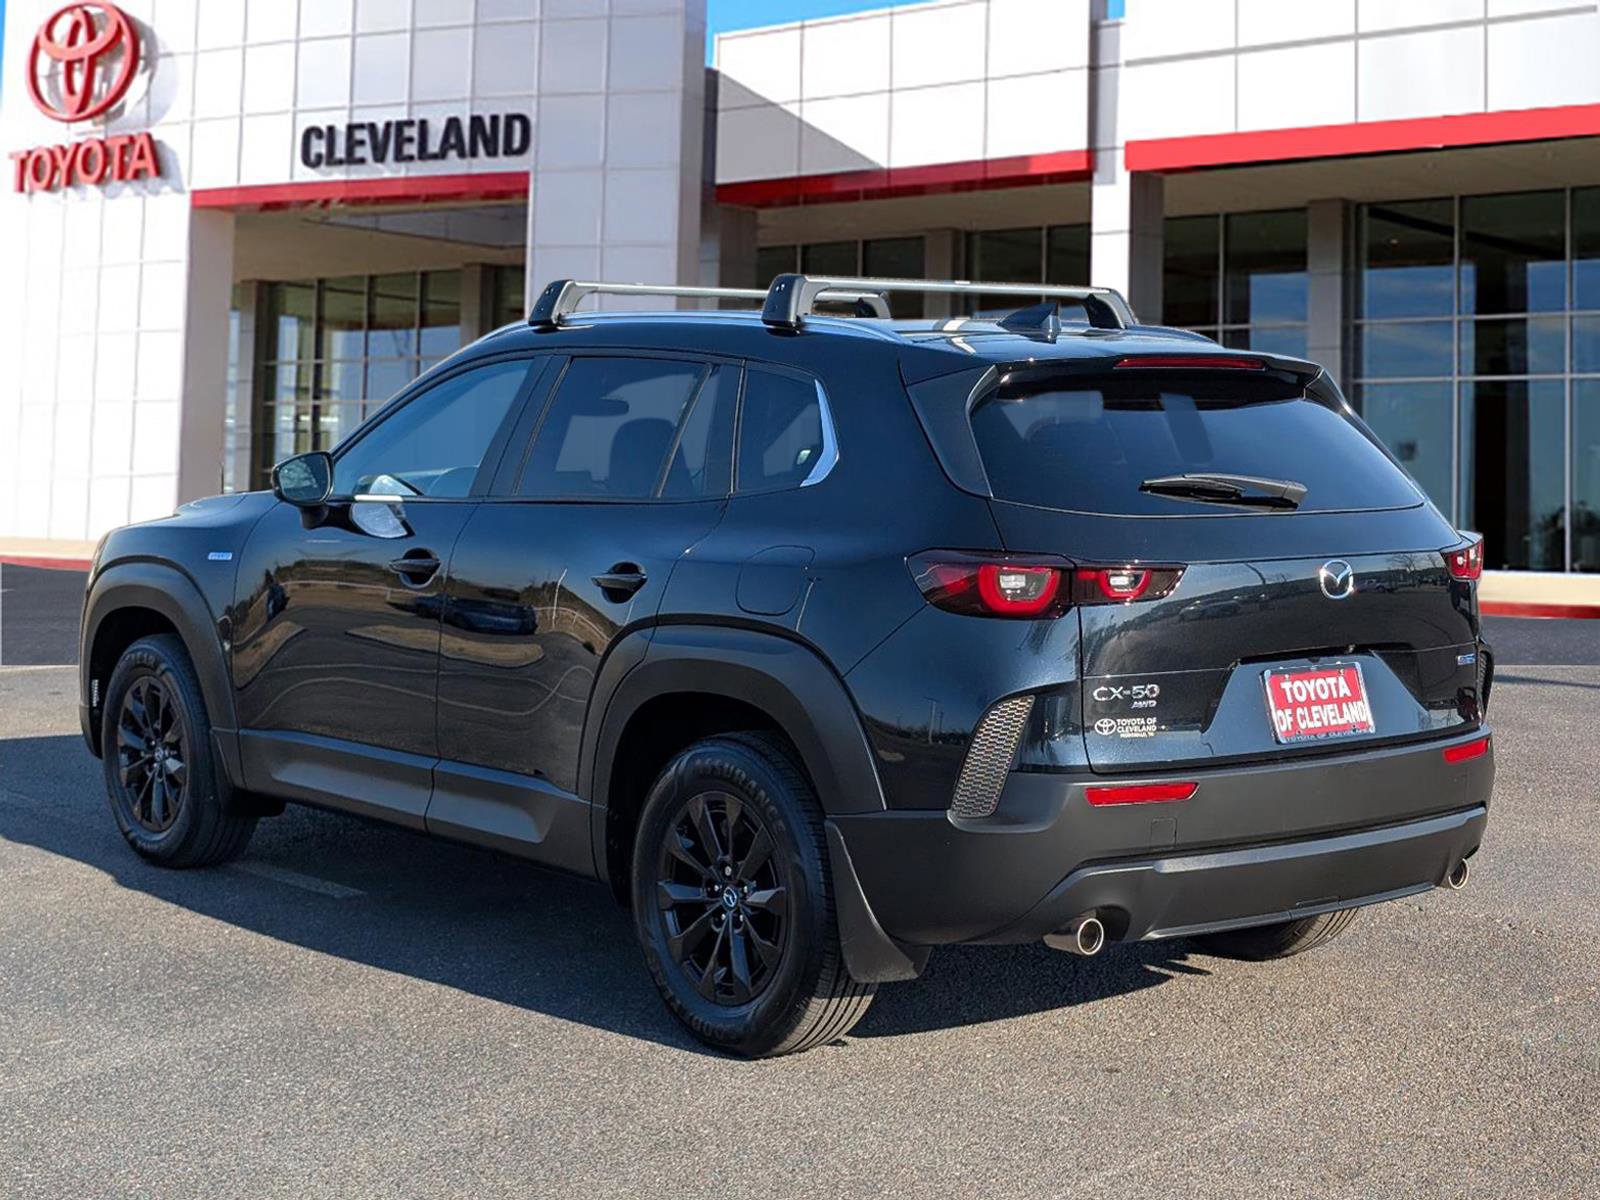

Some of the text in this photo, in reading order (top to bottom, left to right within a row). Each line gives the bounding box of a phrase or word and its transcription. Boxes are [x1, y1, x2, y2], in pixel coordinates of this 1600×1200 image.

[301, 113, 532, 168] CLEVELAND
[9, 131, 162, 194] TOYOTA
[1092, 684, 1160, 701] CX-50
[1280, 675, 1352, 704] TOYOTA
[1116, 717, 1157, 726] TOYOTA OF
[1116, 725, 1157, 733] CLEVELAND
[1277, 700, 1368, 732] OF CLEVELAND
